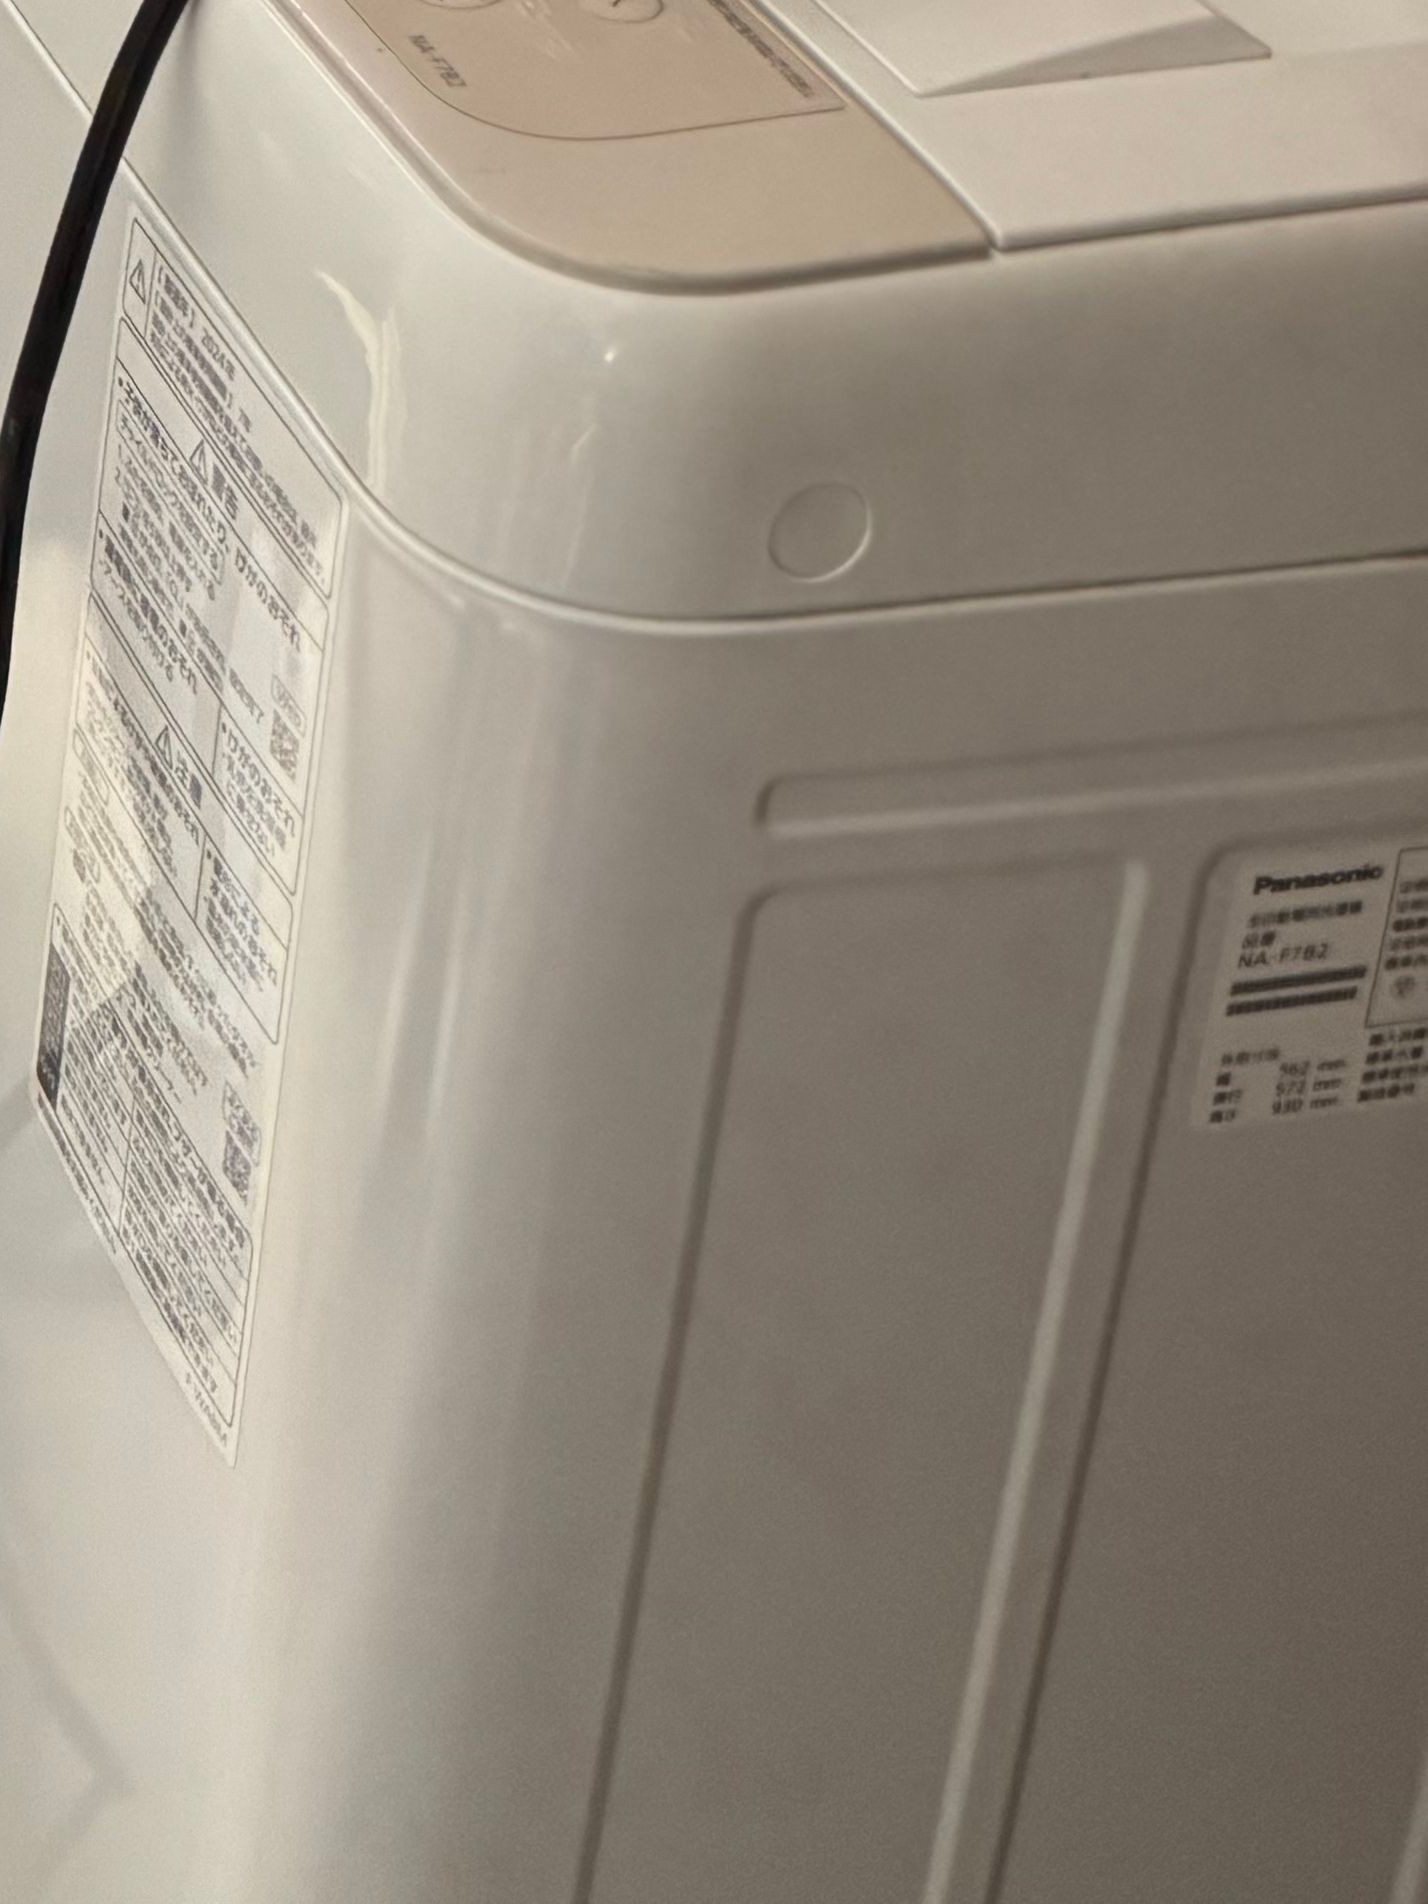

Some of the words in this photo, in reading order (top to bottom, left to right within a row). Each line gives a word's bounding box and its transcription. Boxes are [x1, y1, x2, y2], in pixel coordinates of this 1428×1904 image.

[211, 464, 237, 521] 警告
[227, 723, 294, 844] けがのおそれ
[1254, 865, 1384, 895] Panasonic
